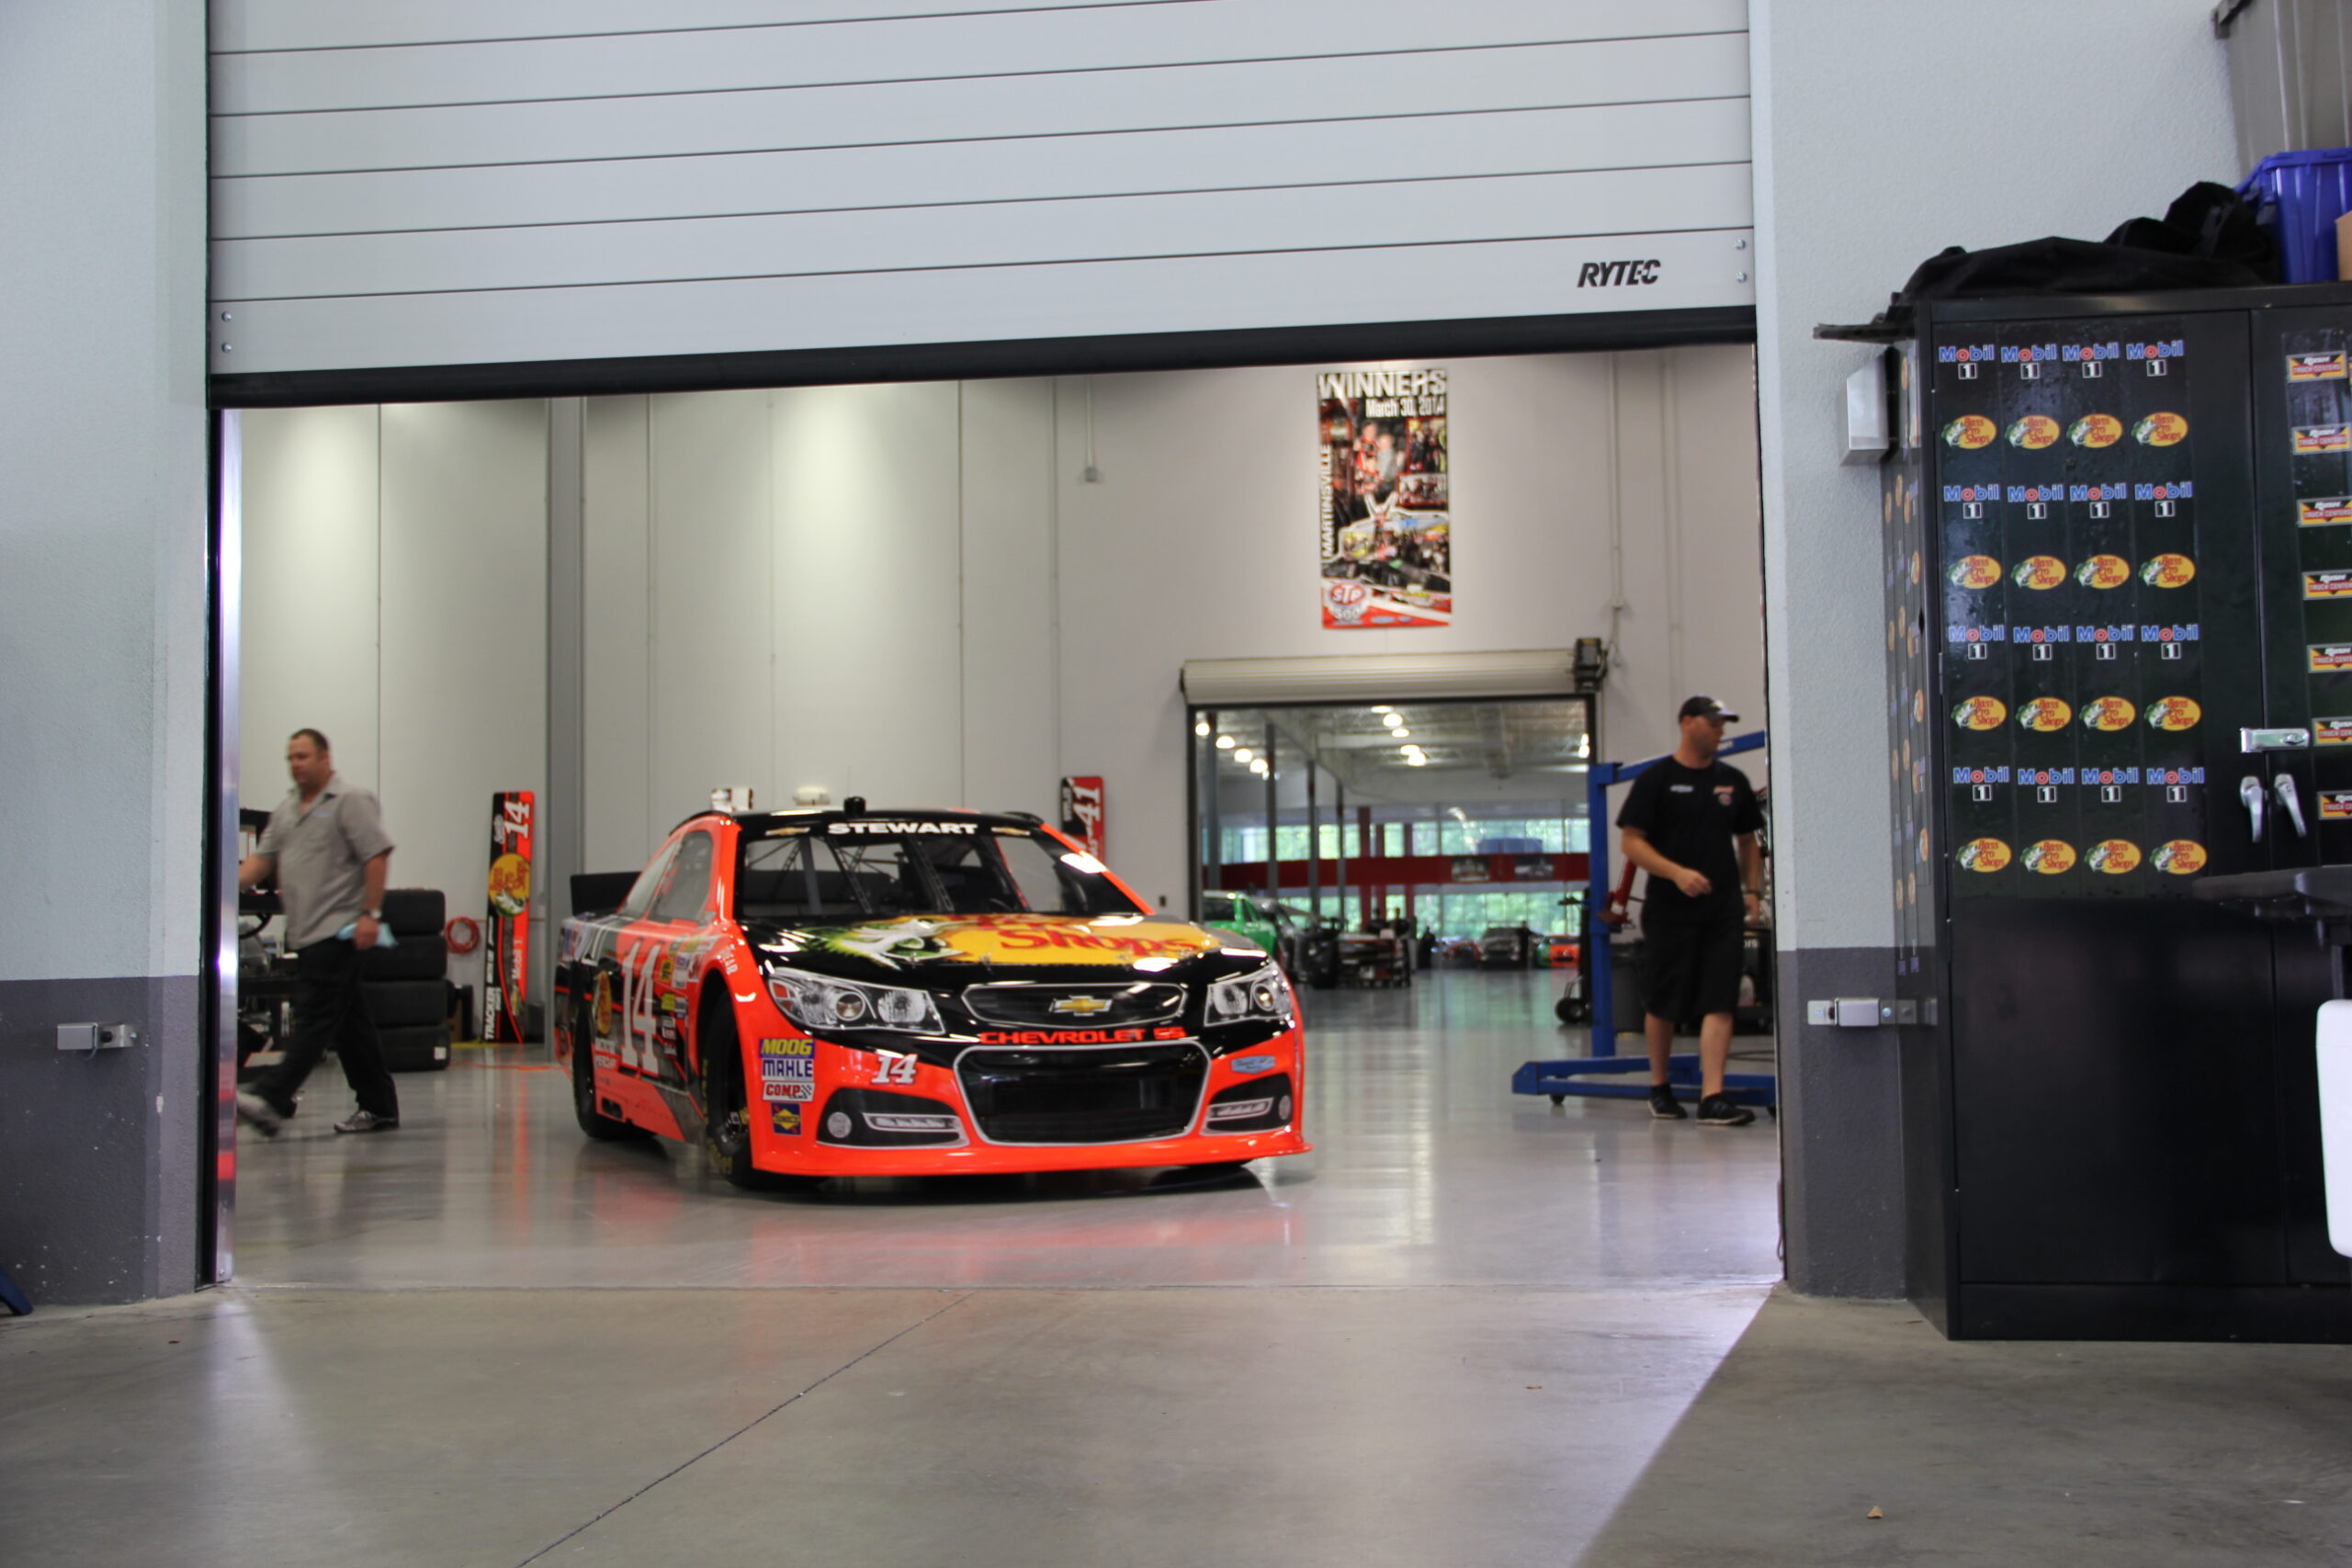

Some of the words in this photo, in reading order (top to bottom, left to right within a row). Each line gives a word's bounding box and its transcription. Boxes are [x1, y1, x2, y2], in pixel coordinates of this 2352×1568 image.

[1577, 259, 1661, 288] RYTEC
[1939, 344, 1995, 362] Mobil
[2001, 344, 2057, 362] Mobil
[2062, 343, 2120, 360] Mobil
[2126, 341, 2184, 358] Mobil
[1317, 370, 1445, 399] WINNERS
[1365, 397, 1399, 418] March
[1419, 394, 1445, 415] 2014
[1964, 416, 1984, 426] Bass
[2028, 416, 2048, 426] Bass
[2090, 415, 2110, 425] Bass
[2155, 413, 2176, 423] Bass
[1964, 435, 1990, 446] Shops
[2028, 435, 2053, 446] Shops
[2090, 434, 2116, 445] Shops
[2155, 433, 2181, 443] Shops
[1943, 484, 1999, 502] Mobil
[2007, 484, 2064, 502] Mobil
[2069, 483, 2127, 501] Mobil
[2134, 482, 2192, 500] Mobil
[1320, 445, 1334, 557] MARTINSVILLE
[1969, 556, 1989, 566] Bass
[2033, 558, 2053, 568] Bass
[2098, 557, 2118, 567] Bass
[2163, 556, 2183, 566] Bass
[1969, 575, 1995, 585] Shops
[2033, 577, 2059, 587] Shops
[2098, 576, 2123, 586] Shops
[2163, 575, 2188, 585] Shops
[1333, 586, 1363, 604] STP
[1949, 626, 2005, 642] Mobil
[2014, 626, 2070, 643] Mobil
[2075, 625, 2133, 642] Mobil
[2141, 624, 2199, 641] Mobil
[1973, 698, 1994, 708] Bass
[2039, 699, 2059, 709] Bass
[2103, 698, 2123, 708] Bass
[2168, 698, 2188, 708] Bass
[1973, 717, 1999, 728] Shops
[2039, 718, 2064, 728] Shops
[2103, 717, 2129, 728] Shops
[2168, 717, 2194, 728] Shops
[1953, 766, 2009, 784] Mobil
[2018, 768, 2075, 784] Mobil
[2082, 768, 2140, 784] Mobil
[2147, 768, 2205, 784] Mobil
[1072, 786, 1101, 822] 41
[504, 800, 530, 839] 14
[828, 822, 978, 835] STEWART
[1979, 840, 1999, 850] Bass
[2043, 841, 2064, 852] Bass
[2109, 841, 2129, 852] Bass
[2174, 841, 2194, 852] Bass
[1979, 859, 2005, 869] Shops
[2043, 861, 2069, 871] Shops
[2109, 861, 2134, 871] Shops
[2174, 861, 2199, 871] Shops
[998, 930, 1196, 956] Shops
[485, 987, 495, 1041] TRACKER
[620, 941, 662, 1077] 14
[979, 1028, 1146, 1044] CHEVROLET
[1153, 1026, 1188, 1040] SS
[761, 1039, 813, 1055] MOOG
[763, 1060, 812, 1078] MAHLE
[871, 1054, 918, 1085] 14
[765, 1084, 800, 1097] COMP
